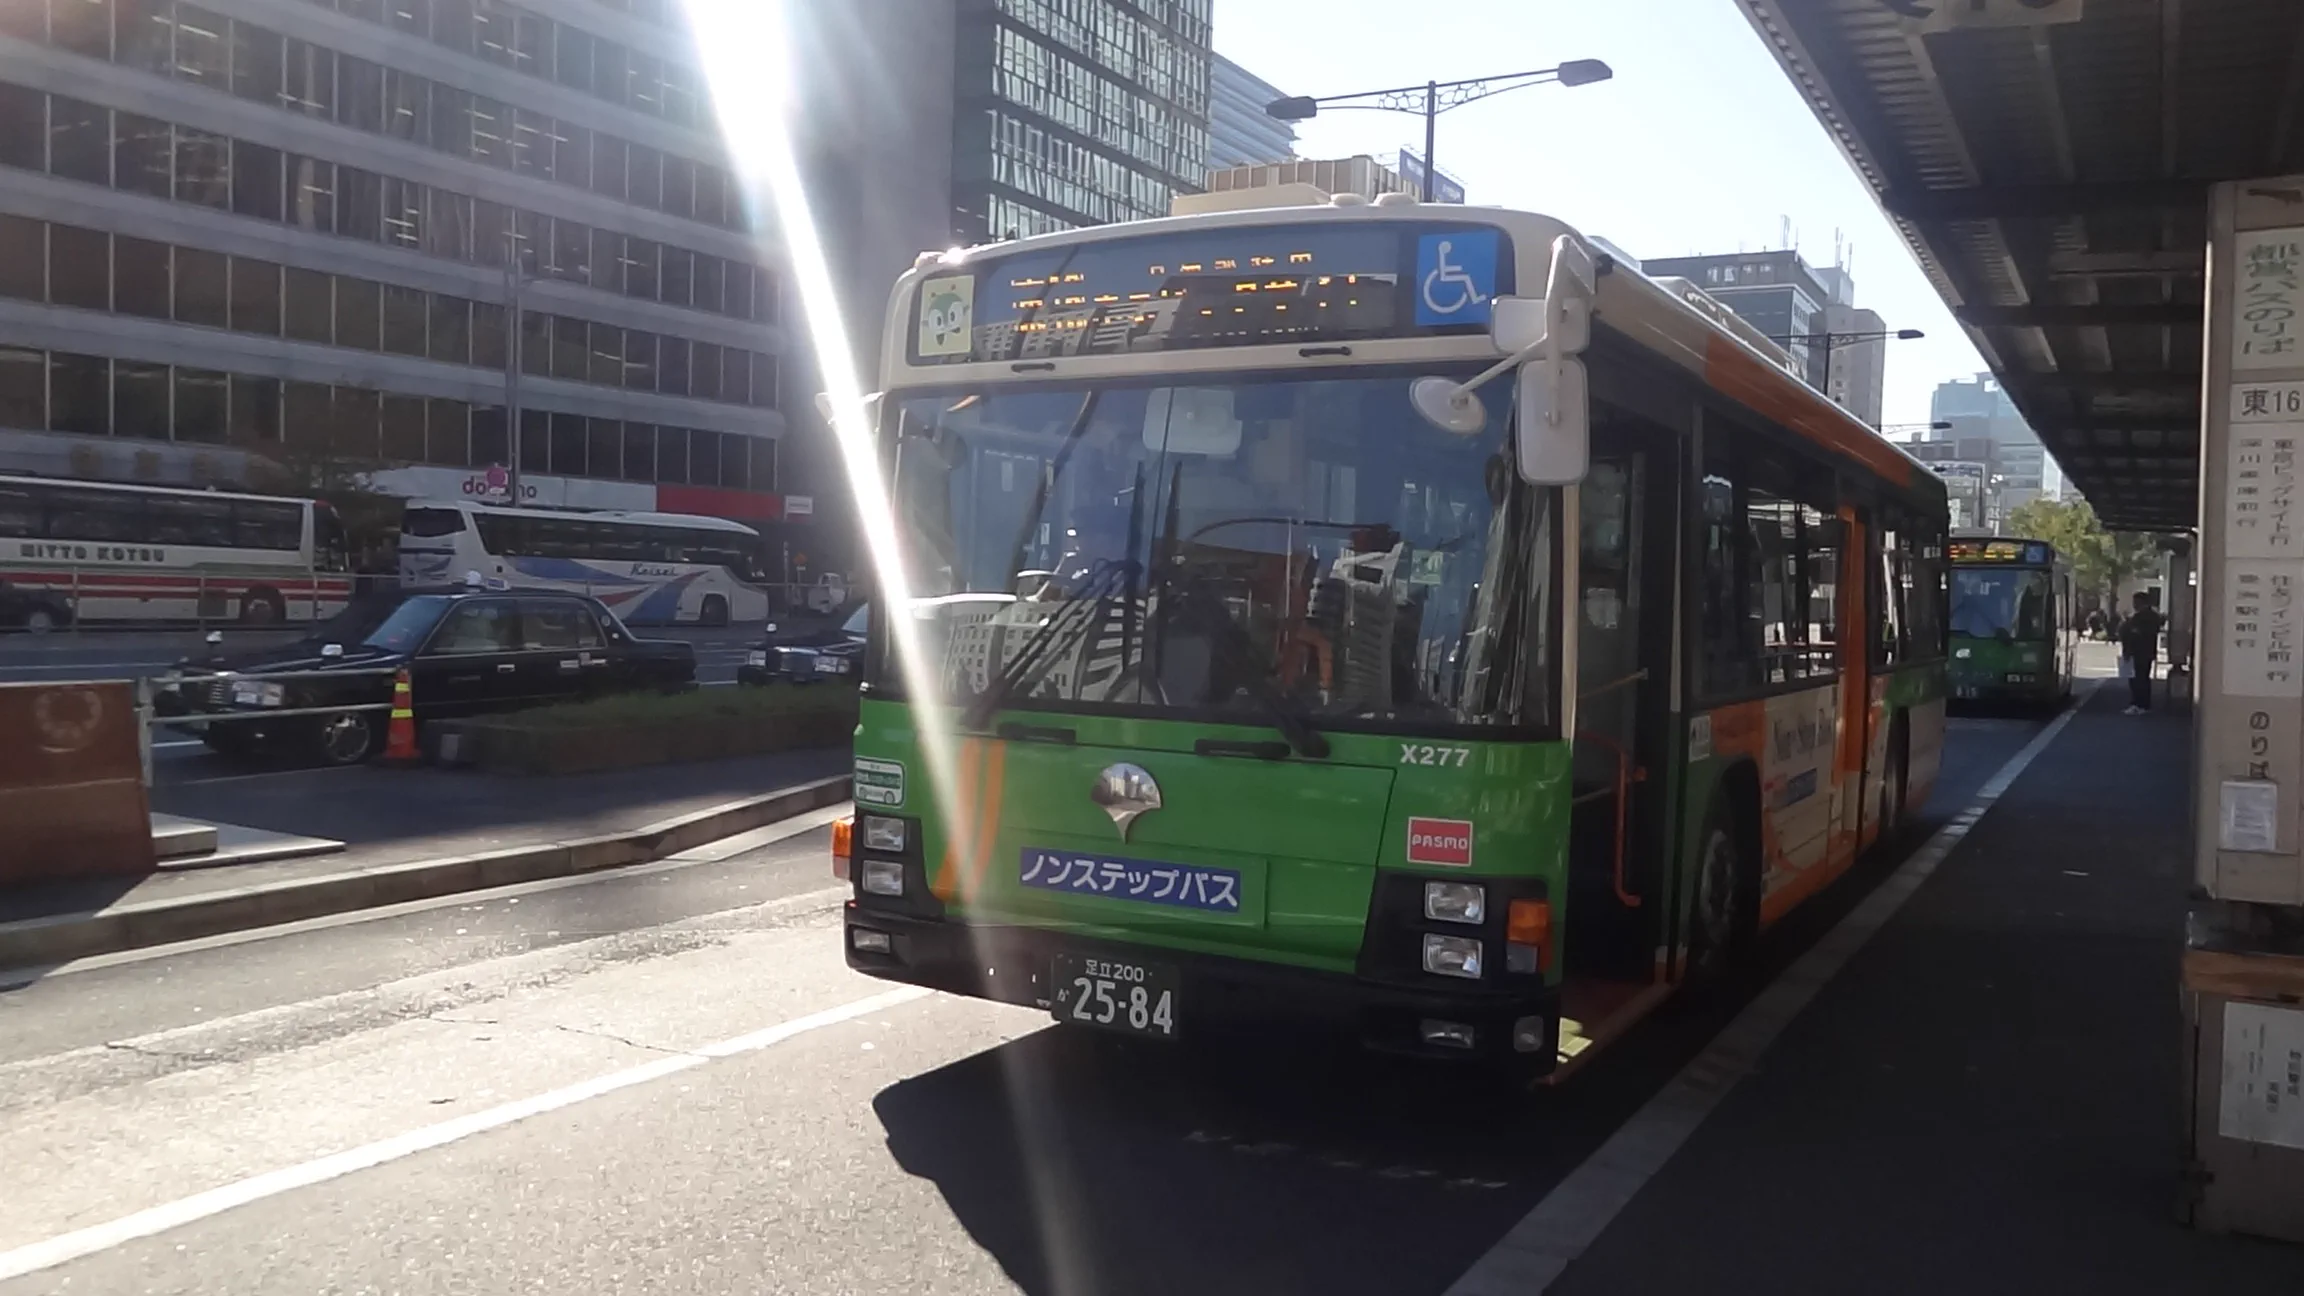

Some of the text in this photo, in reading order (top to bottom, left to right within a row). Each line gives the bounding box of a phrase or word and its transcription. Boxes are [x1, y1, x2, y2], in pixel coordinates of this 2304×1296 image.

[2241, 388, 2301, 416] 東16
[1400, 743, 1470, 767] X277
[1411, 834, 1468, 850] PASMO
[1021, 854, 1238, 907] ノンステップバス
[1073, 977, 1173, 1034] 25-84
